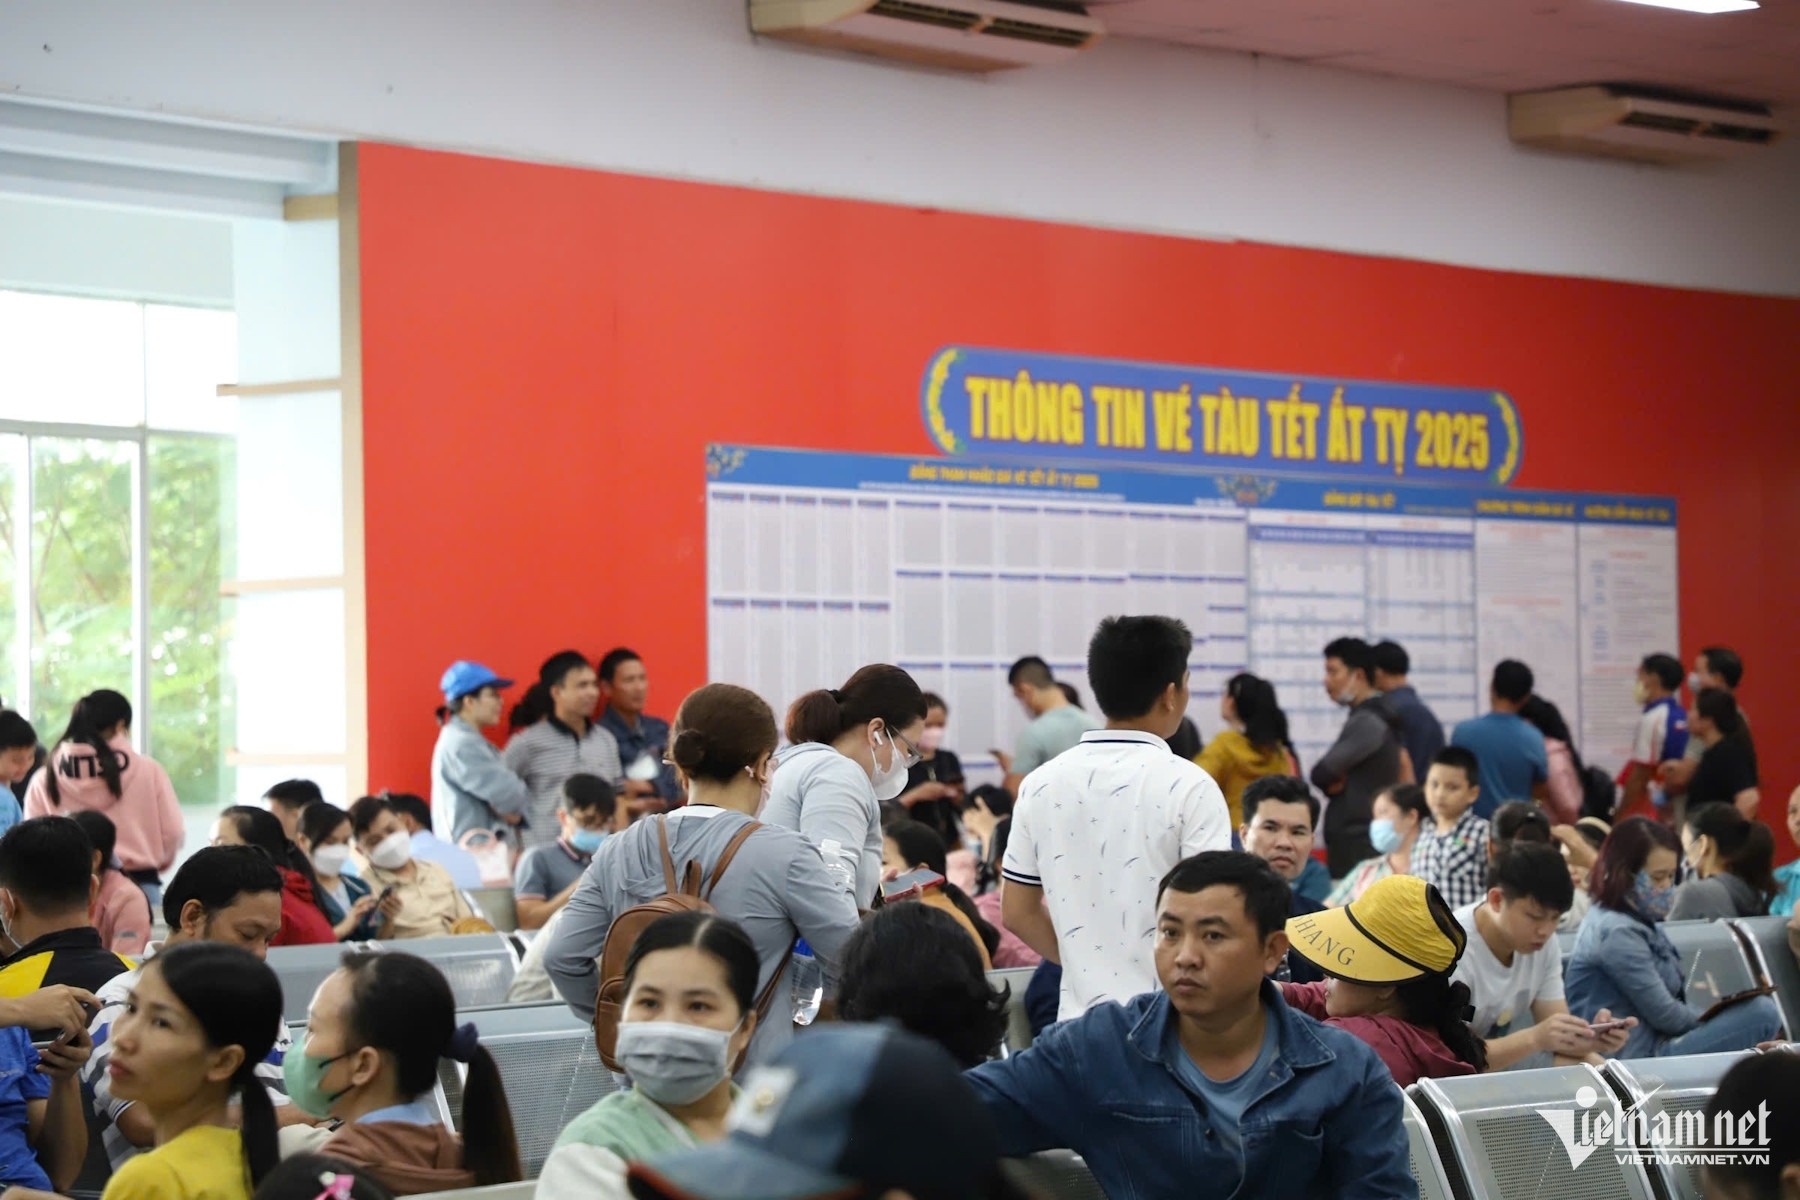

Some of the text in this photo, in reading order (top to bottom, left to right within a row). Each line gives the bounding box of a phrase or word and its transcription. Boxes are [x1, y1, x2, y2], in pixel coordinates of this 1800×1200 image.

[965, 369, 1084, 445] THÔNG
[1091, 385, 1146, 448] TIN
[1152, 383, 1193, 452] VÉ
[1199, 386, 1260, 457] TÀU
[1266, 382, 1320, 461] TẾT
[1372, 407, 1408, 475] TỴ
[1415, 410, 1490, 471] 2025
